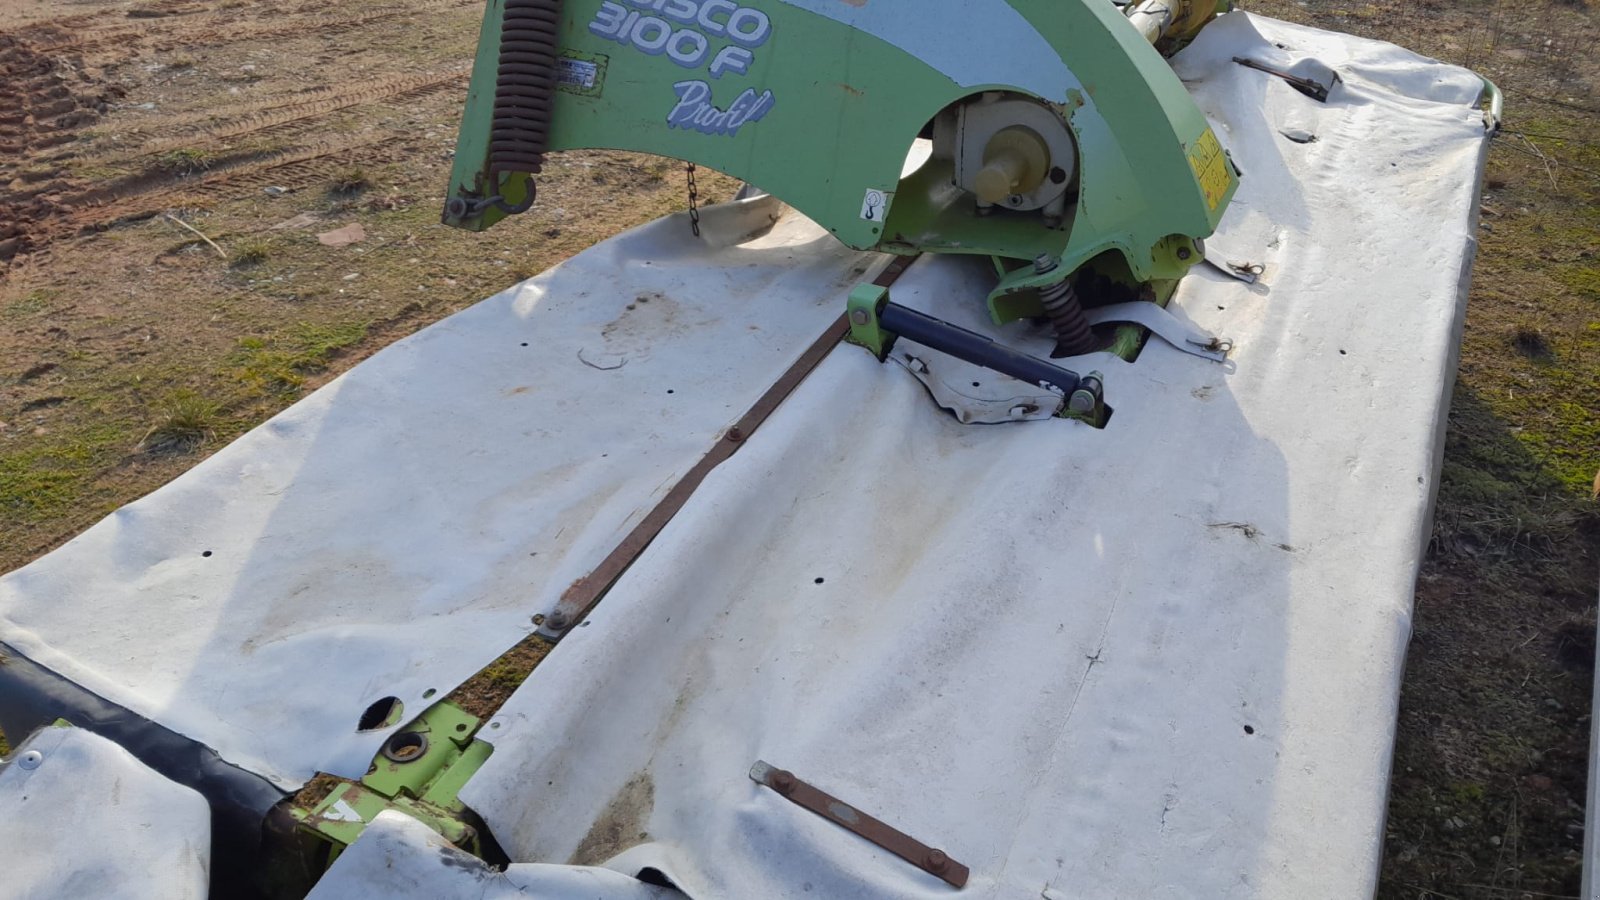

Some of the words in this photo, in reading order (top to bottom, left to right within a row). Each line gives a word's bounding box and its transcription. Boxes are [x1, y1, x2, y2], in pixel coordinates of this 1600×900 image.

[588, 1, 710, 68] 3100
[708, 45, 754, 79] F
[617, 0, 772, 47] SCO
[667, 79, 775, 137] Profil
